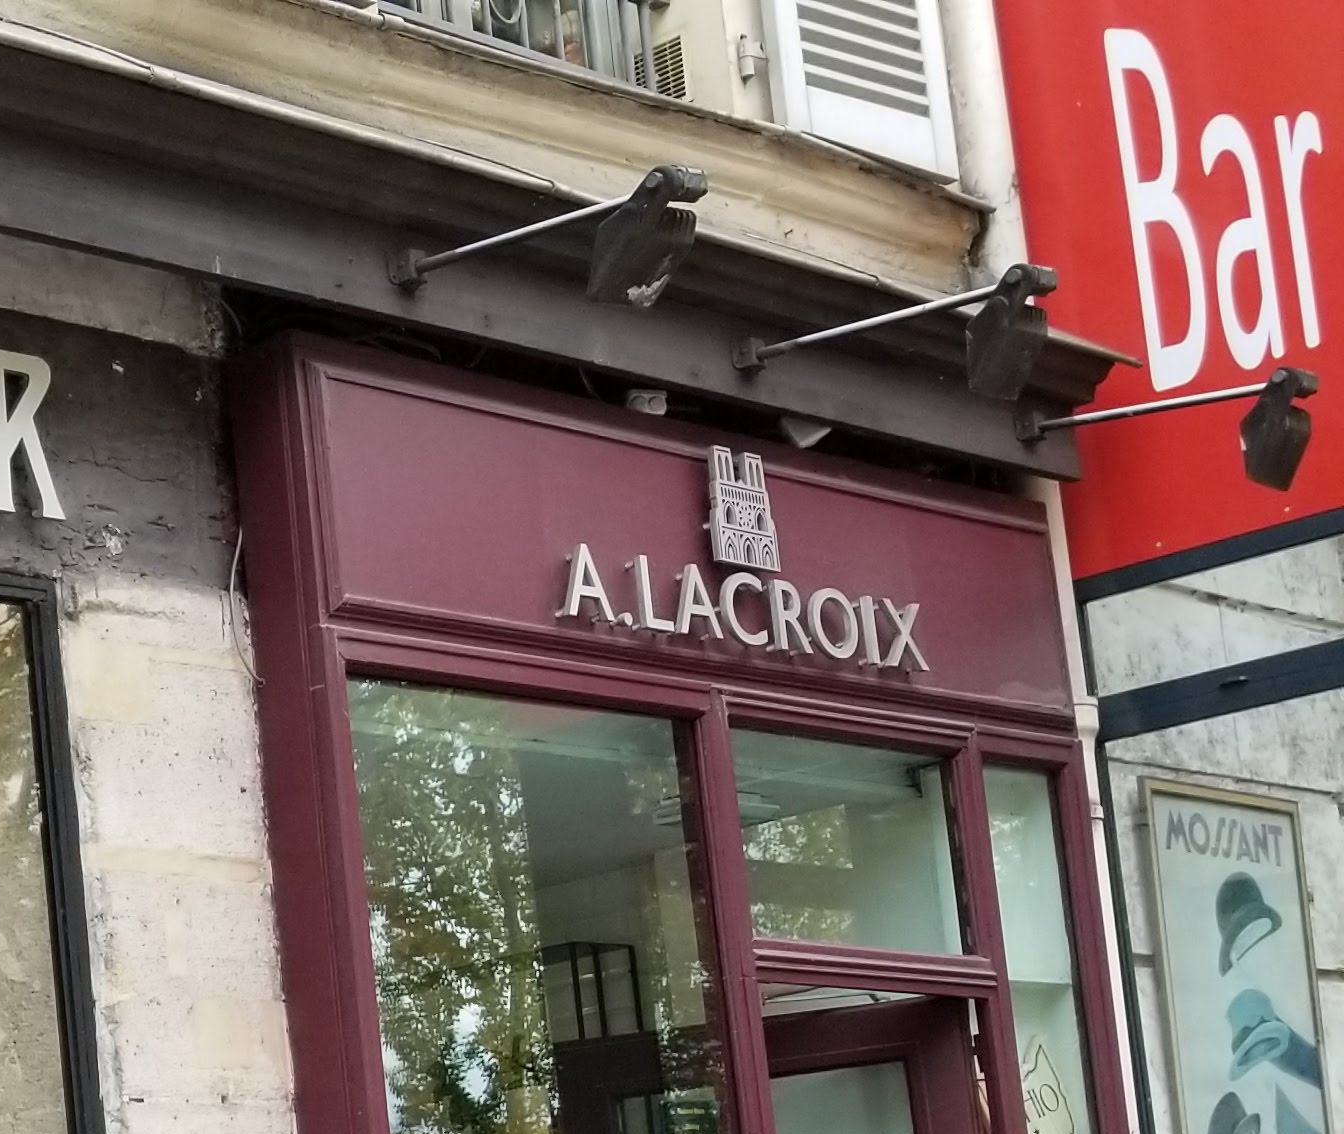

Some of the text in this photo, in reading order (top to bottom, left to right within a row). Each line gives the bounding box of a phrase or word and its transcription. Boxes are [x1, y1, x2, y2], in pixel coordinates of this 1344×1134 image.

[1103, 28, 1323, 391] Bar
[1165, 809, 1284, 867] MOSSANT
[1024, 1083, 1060, 1123] HIO
